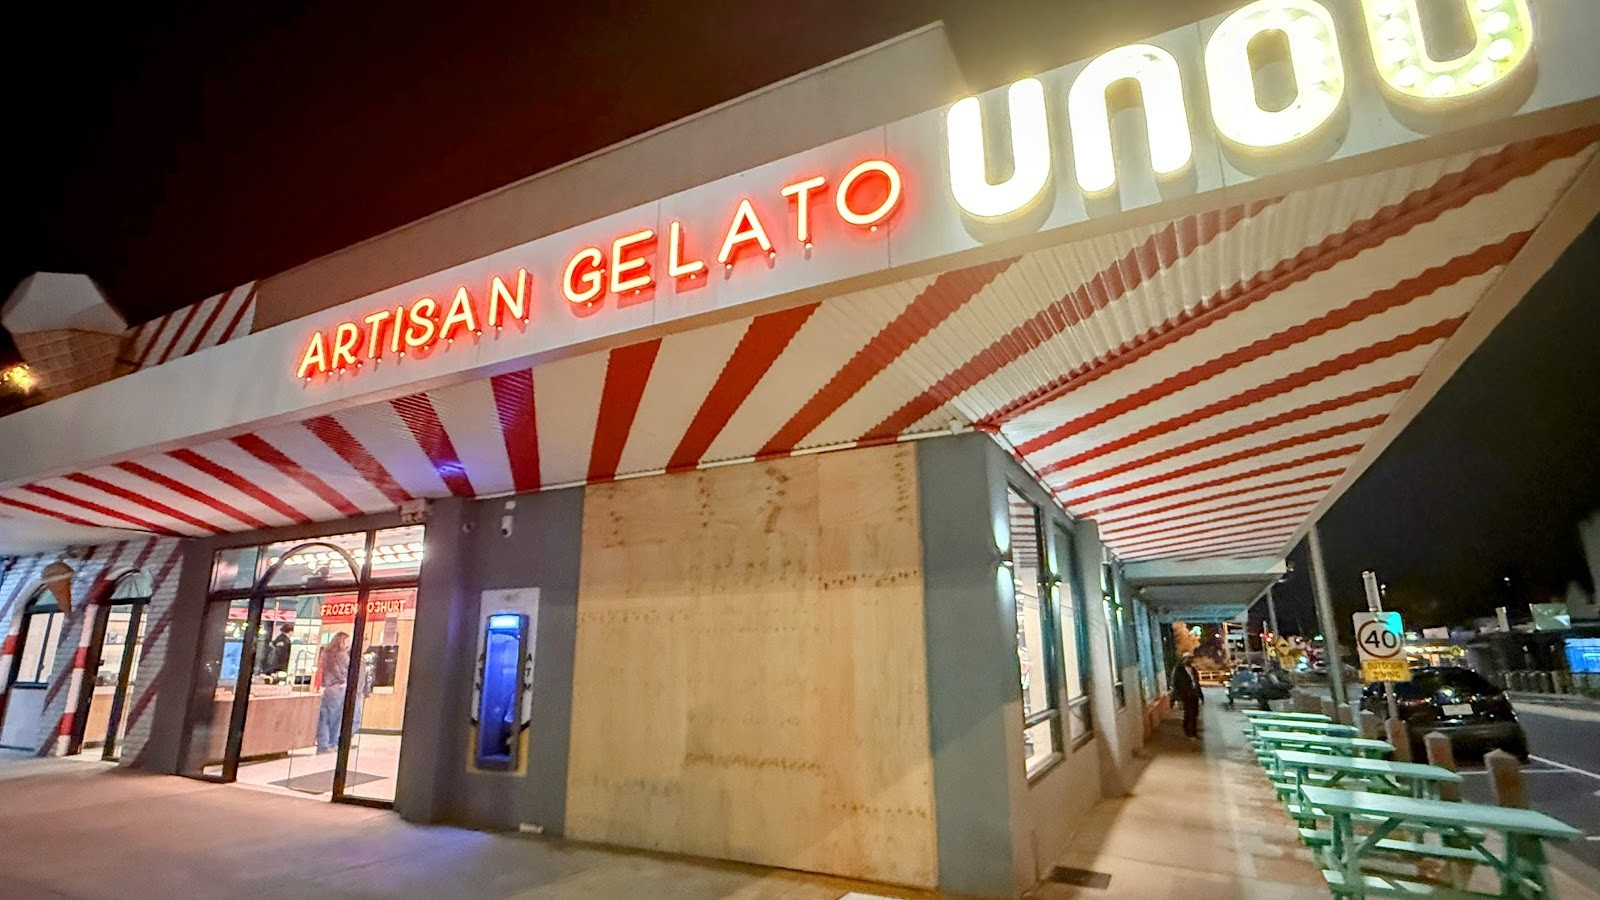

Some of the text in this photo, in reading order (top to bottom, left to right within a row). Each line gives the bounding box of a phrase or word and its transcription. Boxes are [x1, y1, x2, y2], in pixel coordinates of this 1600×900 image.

[296, 159, 903, 381] ARTISAN GELATO
[321, 600, 406, 616] FROZEN OGHURT
[1365, 630, 1396, 648] 40
